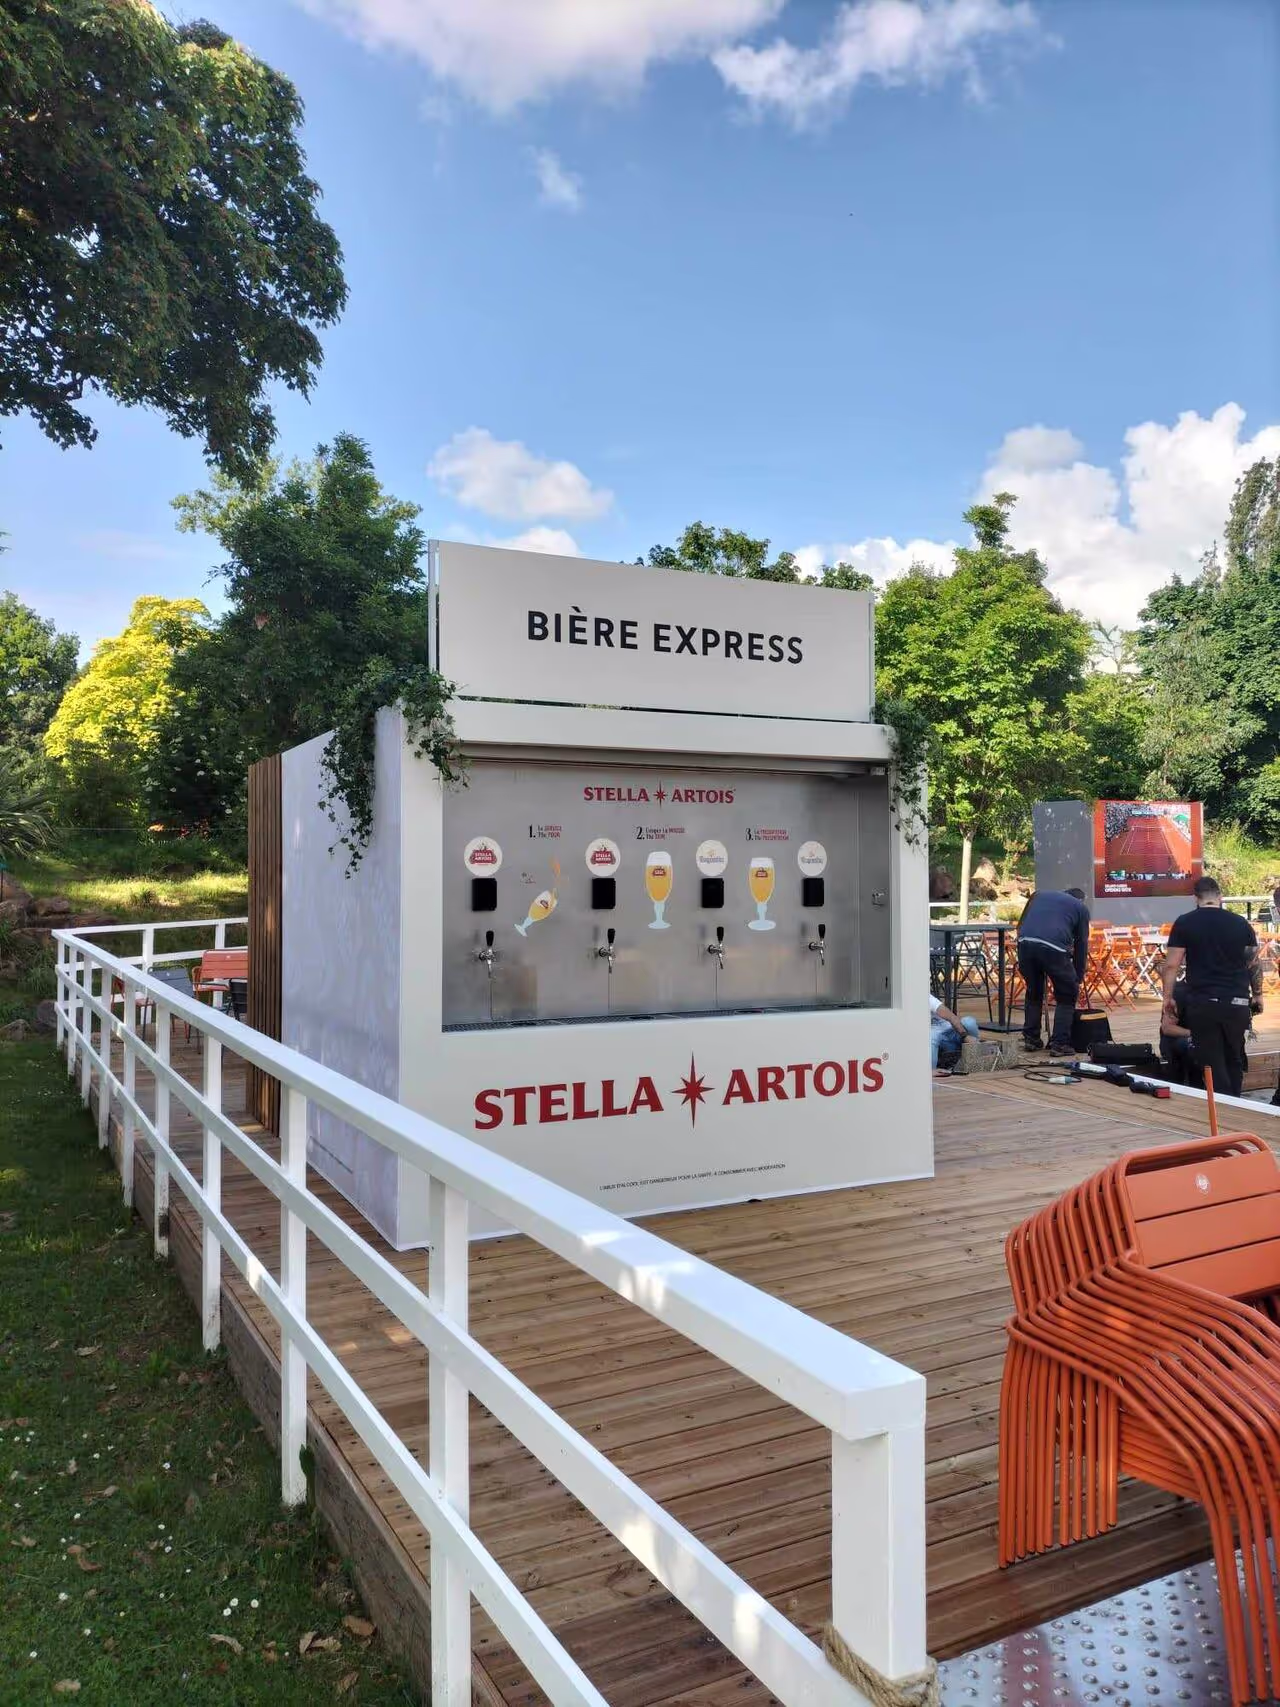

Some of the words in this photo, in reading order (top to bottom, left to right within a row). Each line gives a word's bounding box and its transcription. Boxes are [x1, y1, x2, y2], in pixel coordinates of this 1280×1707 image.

[528, 606, 638, 650] BIÈRE
[653, 623, 804, 664] EXPRESS
[583, 786, 650, 802] STELLA
[671, 788, 735, 804] ARTOIS
[528, 824, 537, 839] 1.
[636, 826, 646, 841] 2.
[745, 827, 754, 842] 3.
[474, 1076, 664, 1130] STELLA
